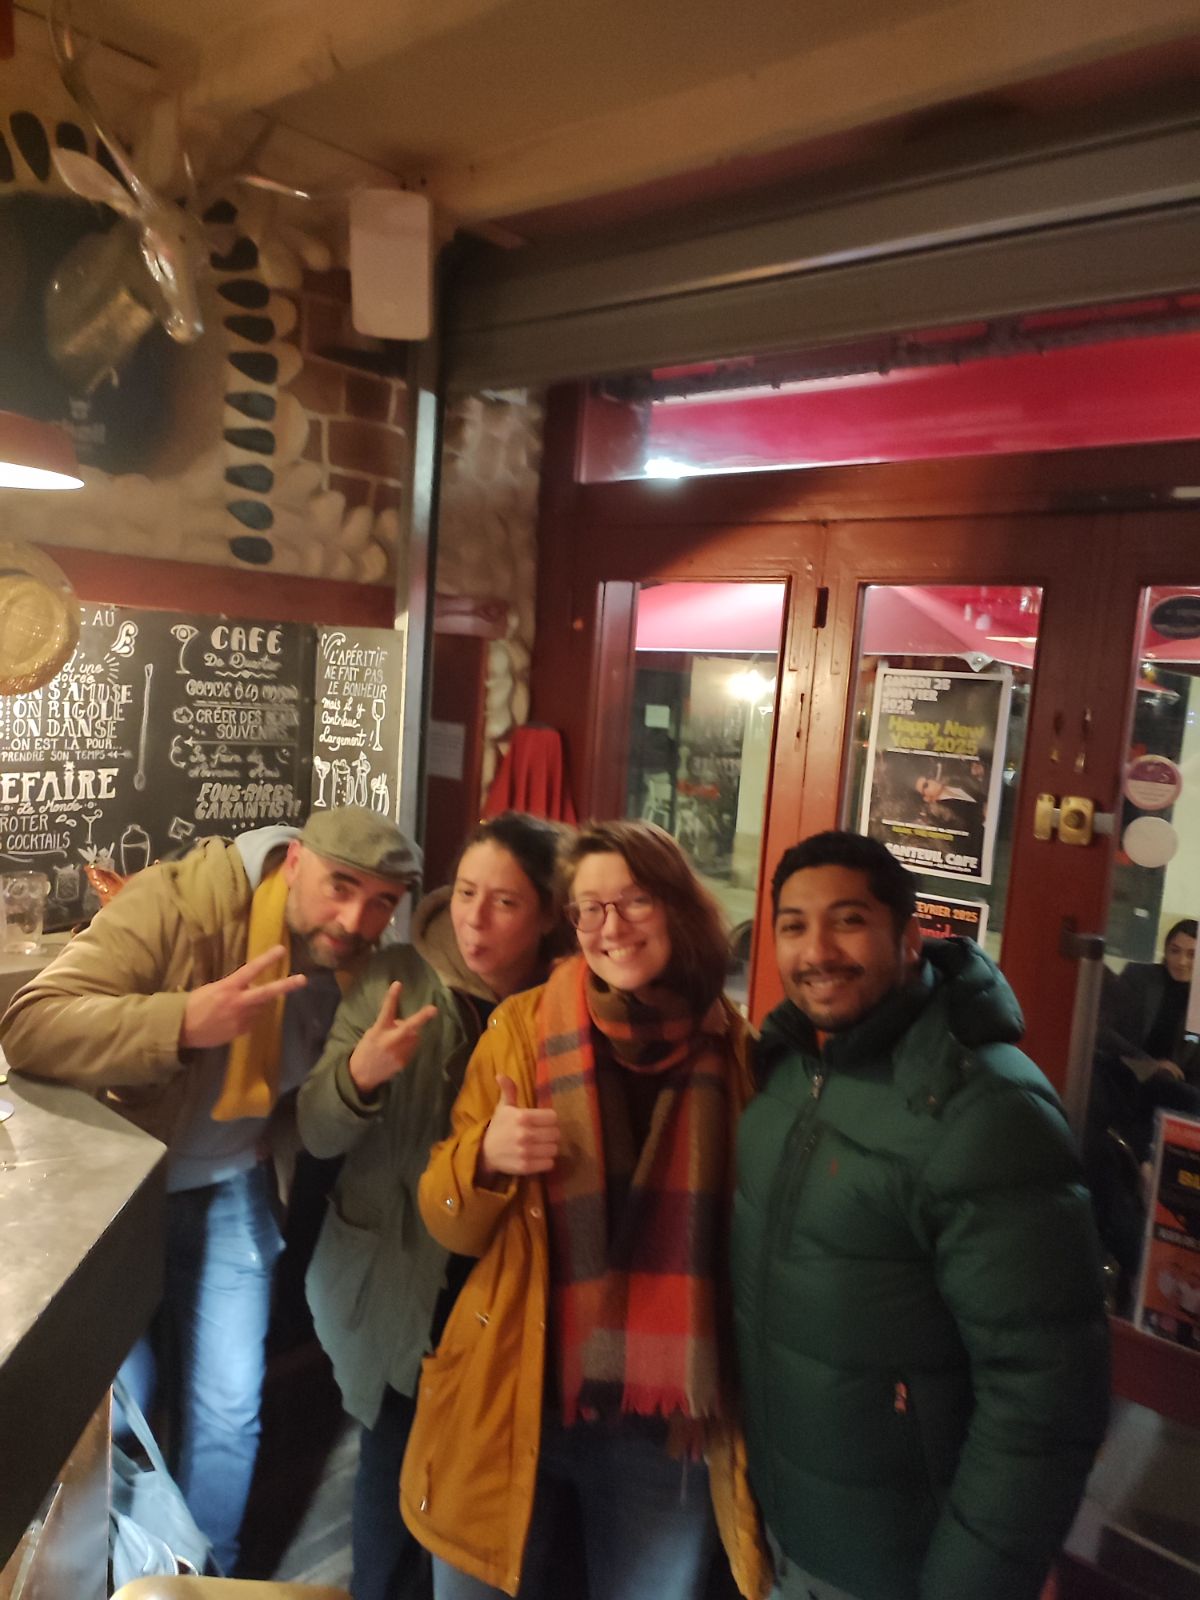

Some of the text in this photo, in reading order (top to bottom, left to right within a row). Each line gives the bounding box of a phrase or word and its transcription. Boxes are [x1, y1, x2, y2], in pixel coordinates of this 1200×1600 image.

[210, 624, 284, 655] CAFÉ
[363, 667, 384, 684] PAS
[48, 680, 133, 705] S'AMUSE
[327, 681, 388, 700] LE BONHEUR
[13, 700, 42, 719] ON
[48, 700, 125, 721] RIGOLE
[195, 705, 237, 725] CRÉER
[12, 718, 118, 739] ON DANSE
[35, 739, 59, 750] EST
[1, 750, 106, 762] PRENDRE SON TEMPS
[39, 799, 82, 814] Monde
[6, 830, 71, 851] COCKTAILS
